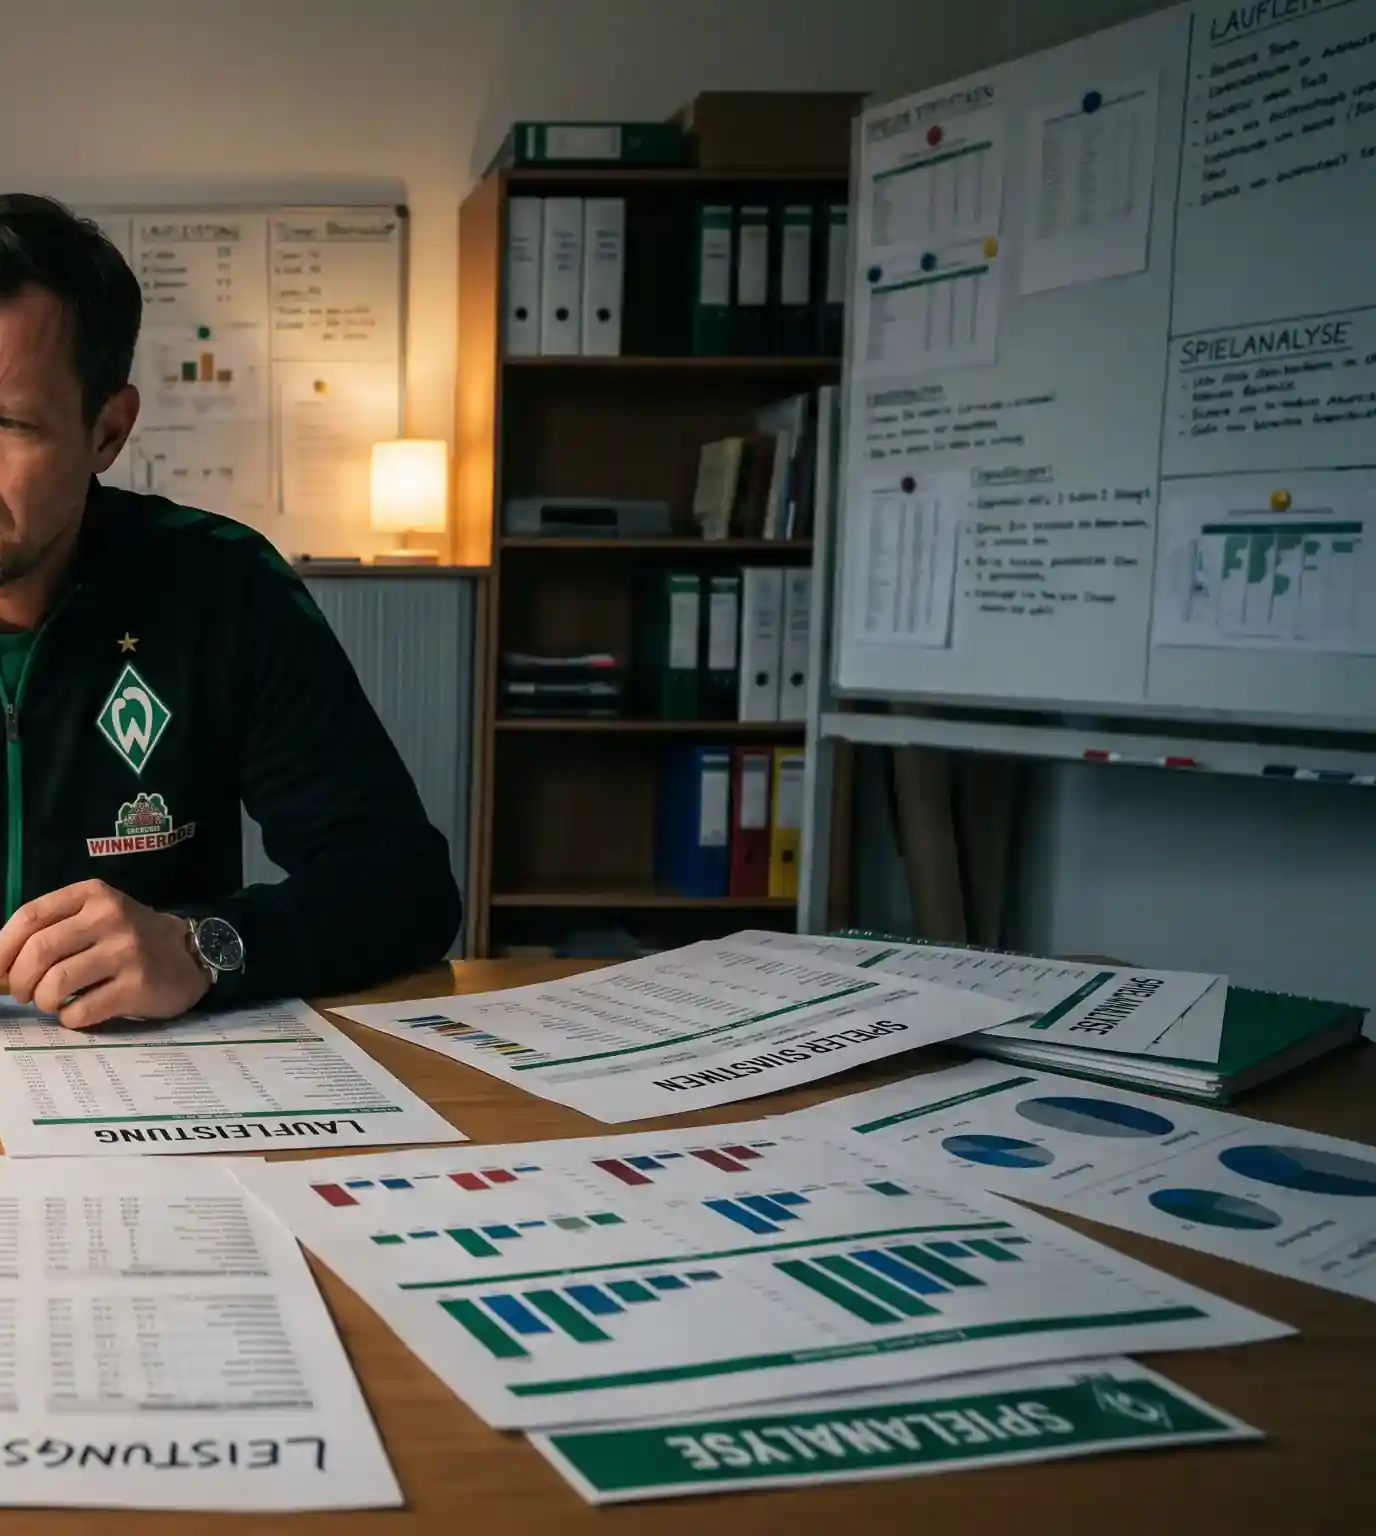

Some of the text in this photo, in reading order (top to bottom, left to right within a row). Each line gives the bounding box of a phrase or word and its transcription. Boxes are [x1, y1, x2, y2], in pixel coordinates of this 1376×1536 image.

[1180, 322, 1353, 365] SPIELANALYSE
[797, 1020, 908, 1053] SPIELER
[93, 1119, 366, 1144] LAUFLEISTUNG
[665, 1399, 1074, 1472] SPIELANALYSE
